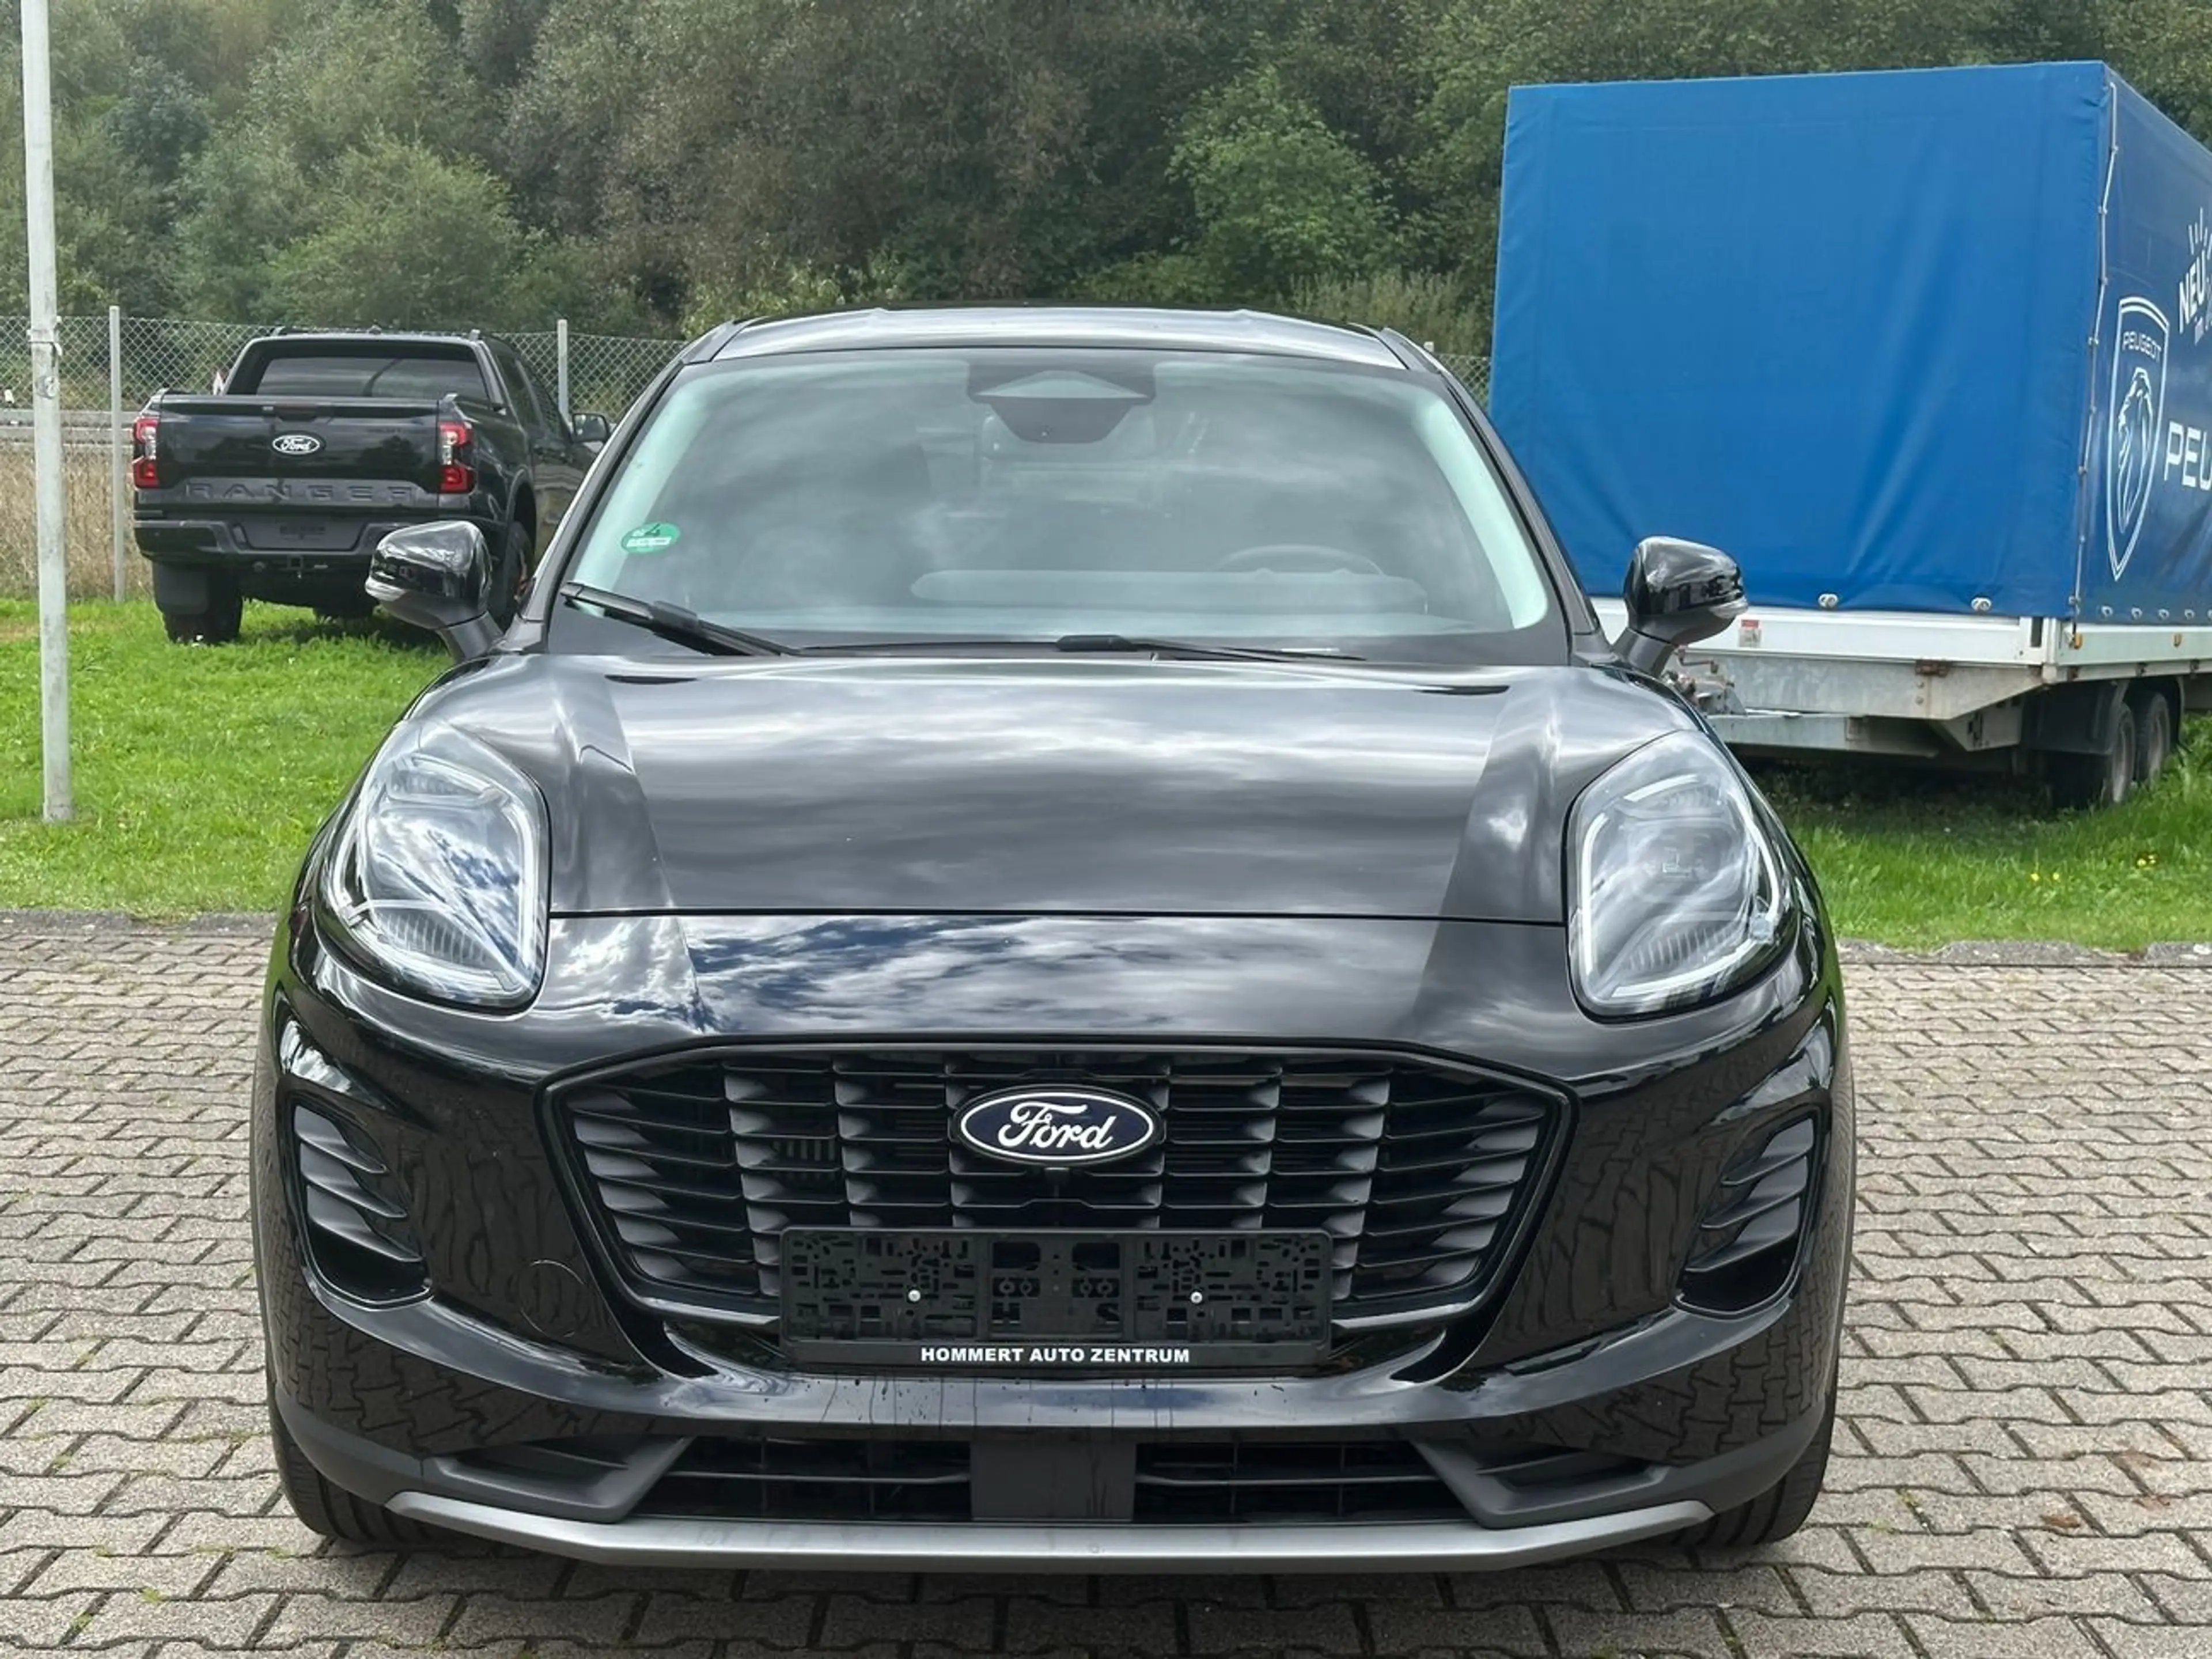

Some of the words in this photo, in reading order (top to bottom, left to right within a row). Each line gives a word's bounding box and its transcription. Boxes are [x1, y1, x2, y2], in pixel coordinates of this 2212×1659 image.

[2122, 331, 2162, 363] PEUGEOT
[280, 438, 312, 450] Ford
[185, 482, 415, 502] RANGER
[998, 1101, 1117, 1149] Ford
[921, 1348, 1024, 1362] HOMMERT
[1029, 1348, 1085, 1362] AUTO
[1090, 1349, 1190, 1363] ZENTRUM
